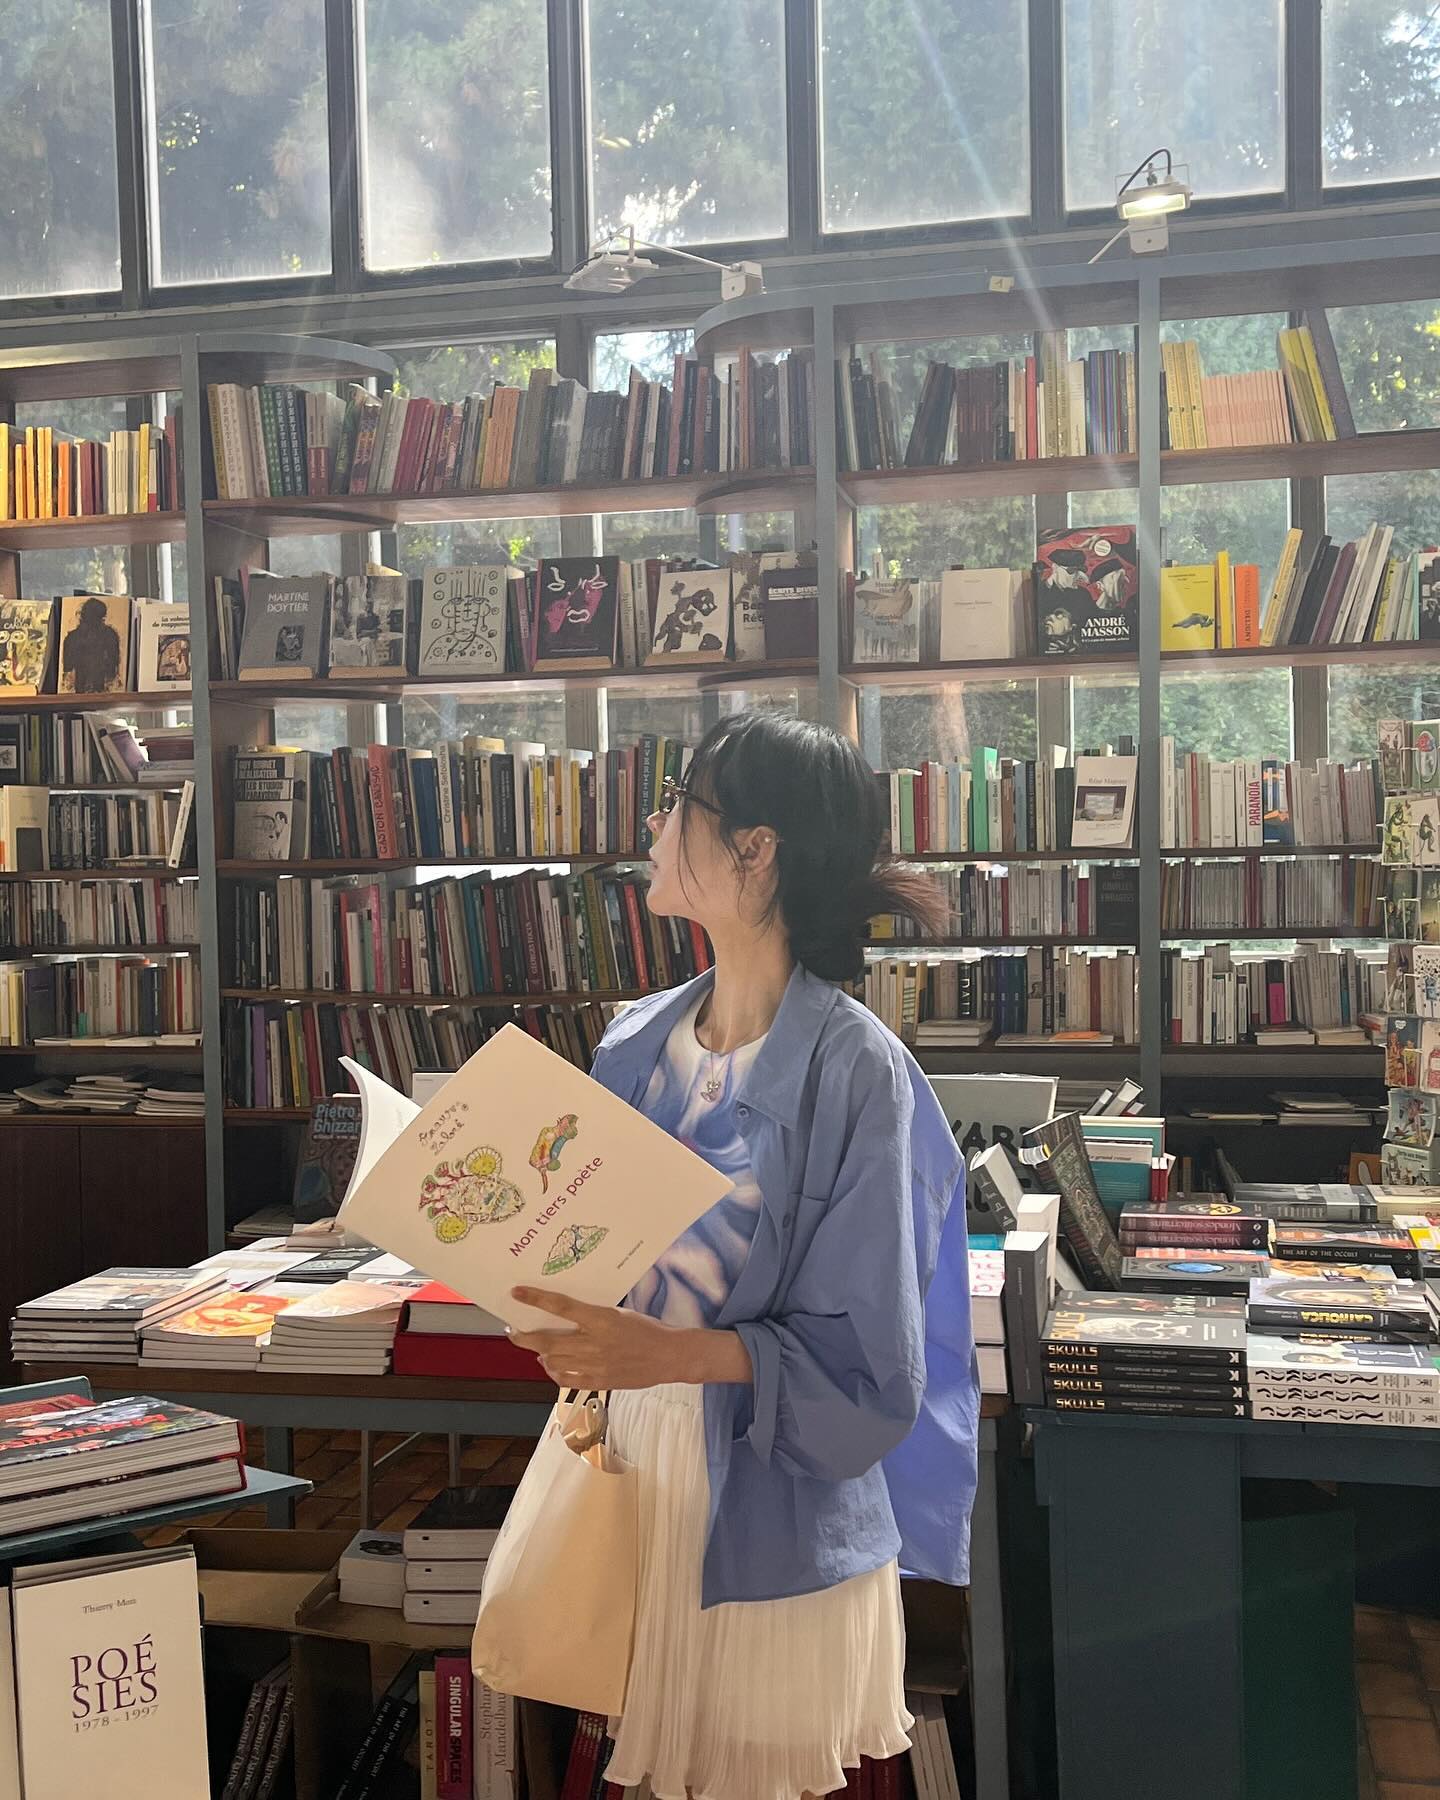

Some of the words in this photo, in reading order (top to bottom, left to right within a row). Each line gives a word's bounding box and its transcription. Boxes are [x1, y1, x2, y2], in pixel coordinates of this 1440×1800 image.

[286, 391, 301, 472] EVERYTHING
[268, 591, 309, 602] MARTINE
[266, 602, 309, 613] DOYTIER
[1085, 614, 1126, 628] ANDRÉ
[1081, 626, 1130, 638] MASSON
[440, 787, 452, 824] Christine
[375, 811, 388, 854] GASTON
[315, 1103, 356, 1119] Pietro
[509, 1227, 539, 1258] Mon
[536, 1194, 567, 1229] tiers
[565, 1155, 604, 1198] poète
[1149, 1218, 1203, 1231] souterrains
[1204, 1220, 1241, 1232] Mondes
[1147, 1233, 1203, 1245] souterrains
[1204, 1235, 1241, 1247] Mondes
[1334, 1250, 1358, 1258] OCCULT
[1047, 1344, 1098, 1357] SKULLS
[1048, 1362, 1099, 1375] SKULLS
[1053, 1380, 1103, 1392] SKULLS
[1056, 1398, 1105, 1410] SKULLS
[70, 1633, 157, 1688] POÉ
[72, 1670, 158, 1719] SIES
[75, 1716, 110, 1733] 1978
[125, 1704, 159, 1721] 1997
[479, 1683, 492, 1740] Stéphan
[272, 1711, 290, 1752] Cosmic
[494, 1692, 507, 1767] Mandelbau
[424, 1716, 434, 1771] TAROT
